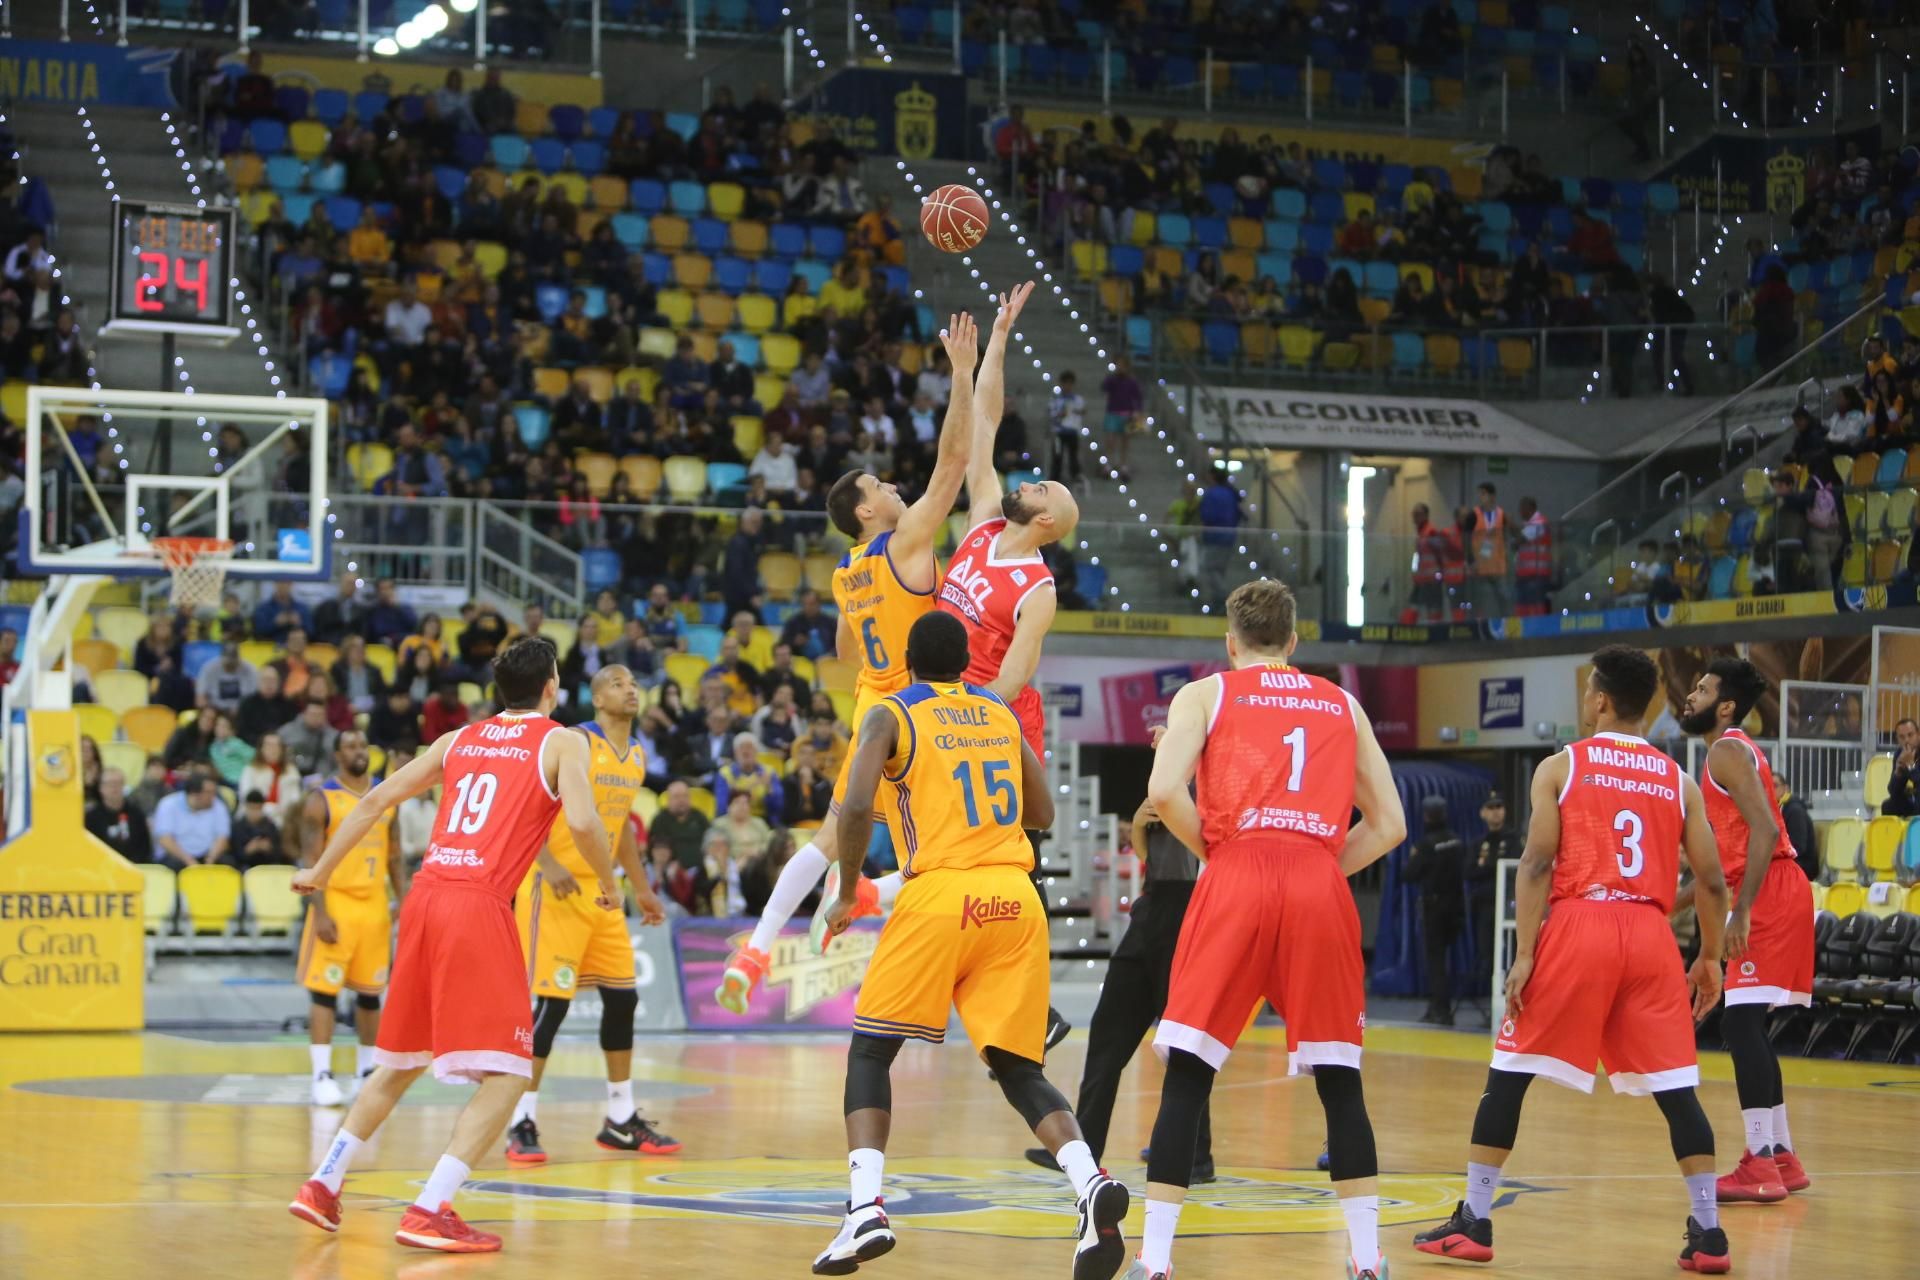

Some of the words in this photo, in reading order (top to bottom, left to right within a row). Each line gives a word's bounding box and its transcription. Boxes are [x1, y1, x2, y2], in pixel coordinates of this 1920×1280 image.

[134, 252, 209, 312] 24
[861, 616, 889, 671] 6
[1260, 672, 1312, 689] AUDA
[933, 705, 990, 726] O'NEALE
[1249, 695, 1342, 716] FUTURAUTO
[1282, 727, 1306, 792] 1
[1587, 746, 1668, 776] MACHADO
[446, 772, 498, 835] 19
[952, 759, 1018, 827] 15
[1594, 773, 1676, 801] FUTURAUTO
[1262, 807, 1303, 819] TERRES
[1306, 812, 1321, 822] DE
[1613, 808, 1645, 879] 3
[0, 892, 137, 919] ERBALIFE
[961, 894, 1022, 930] Kalise
[18, 924, 100, 957] Gran
